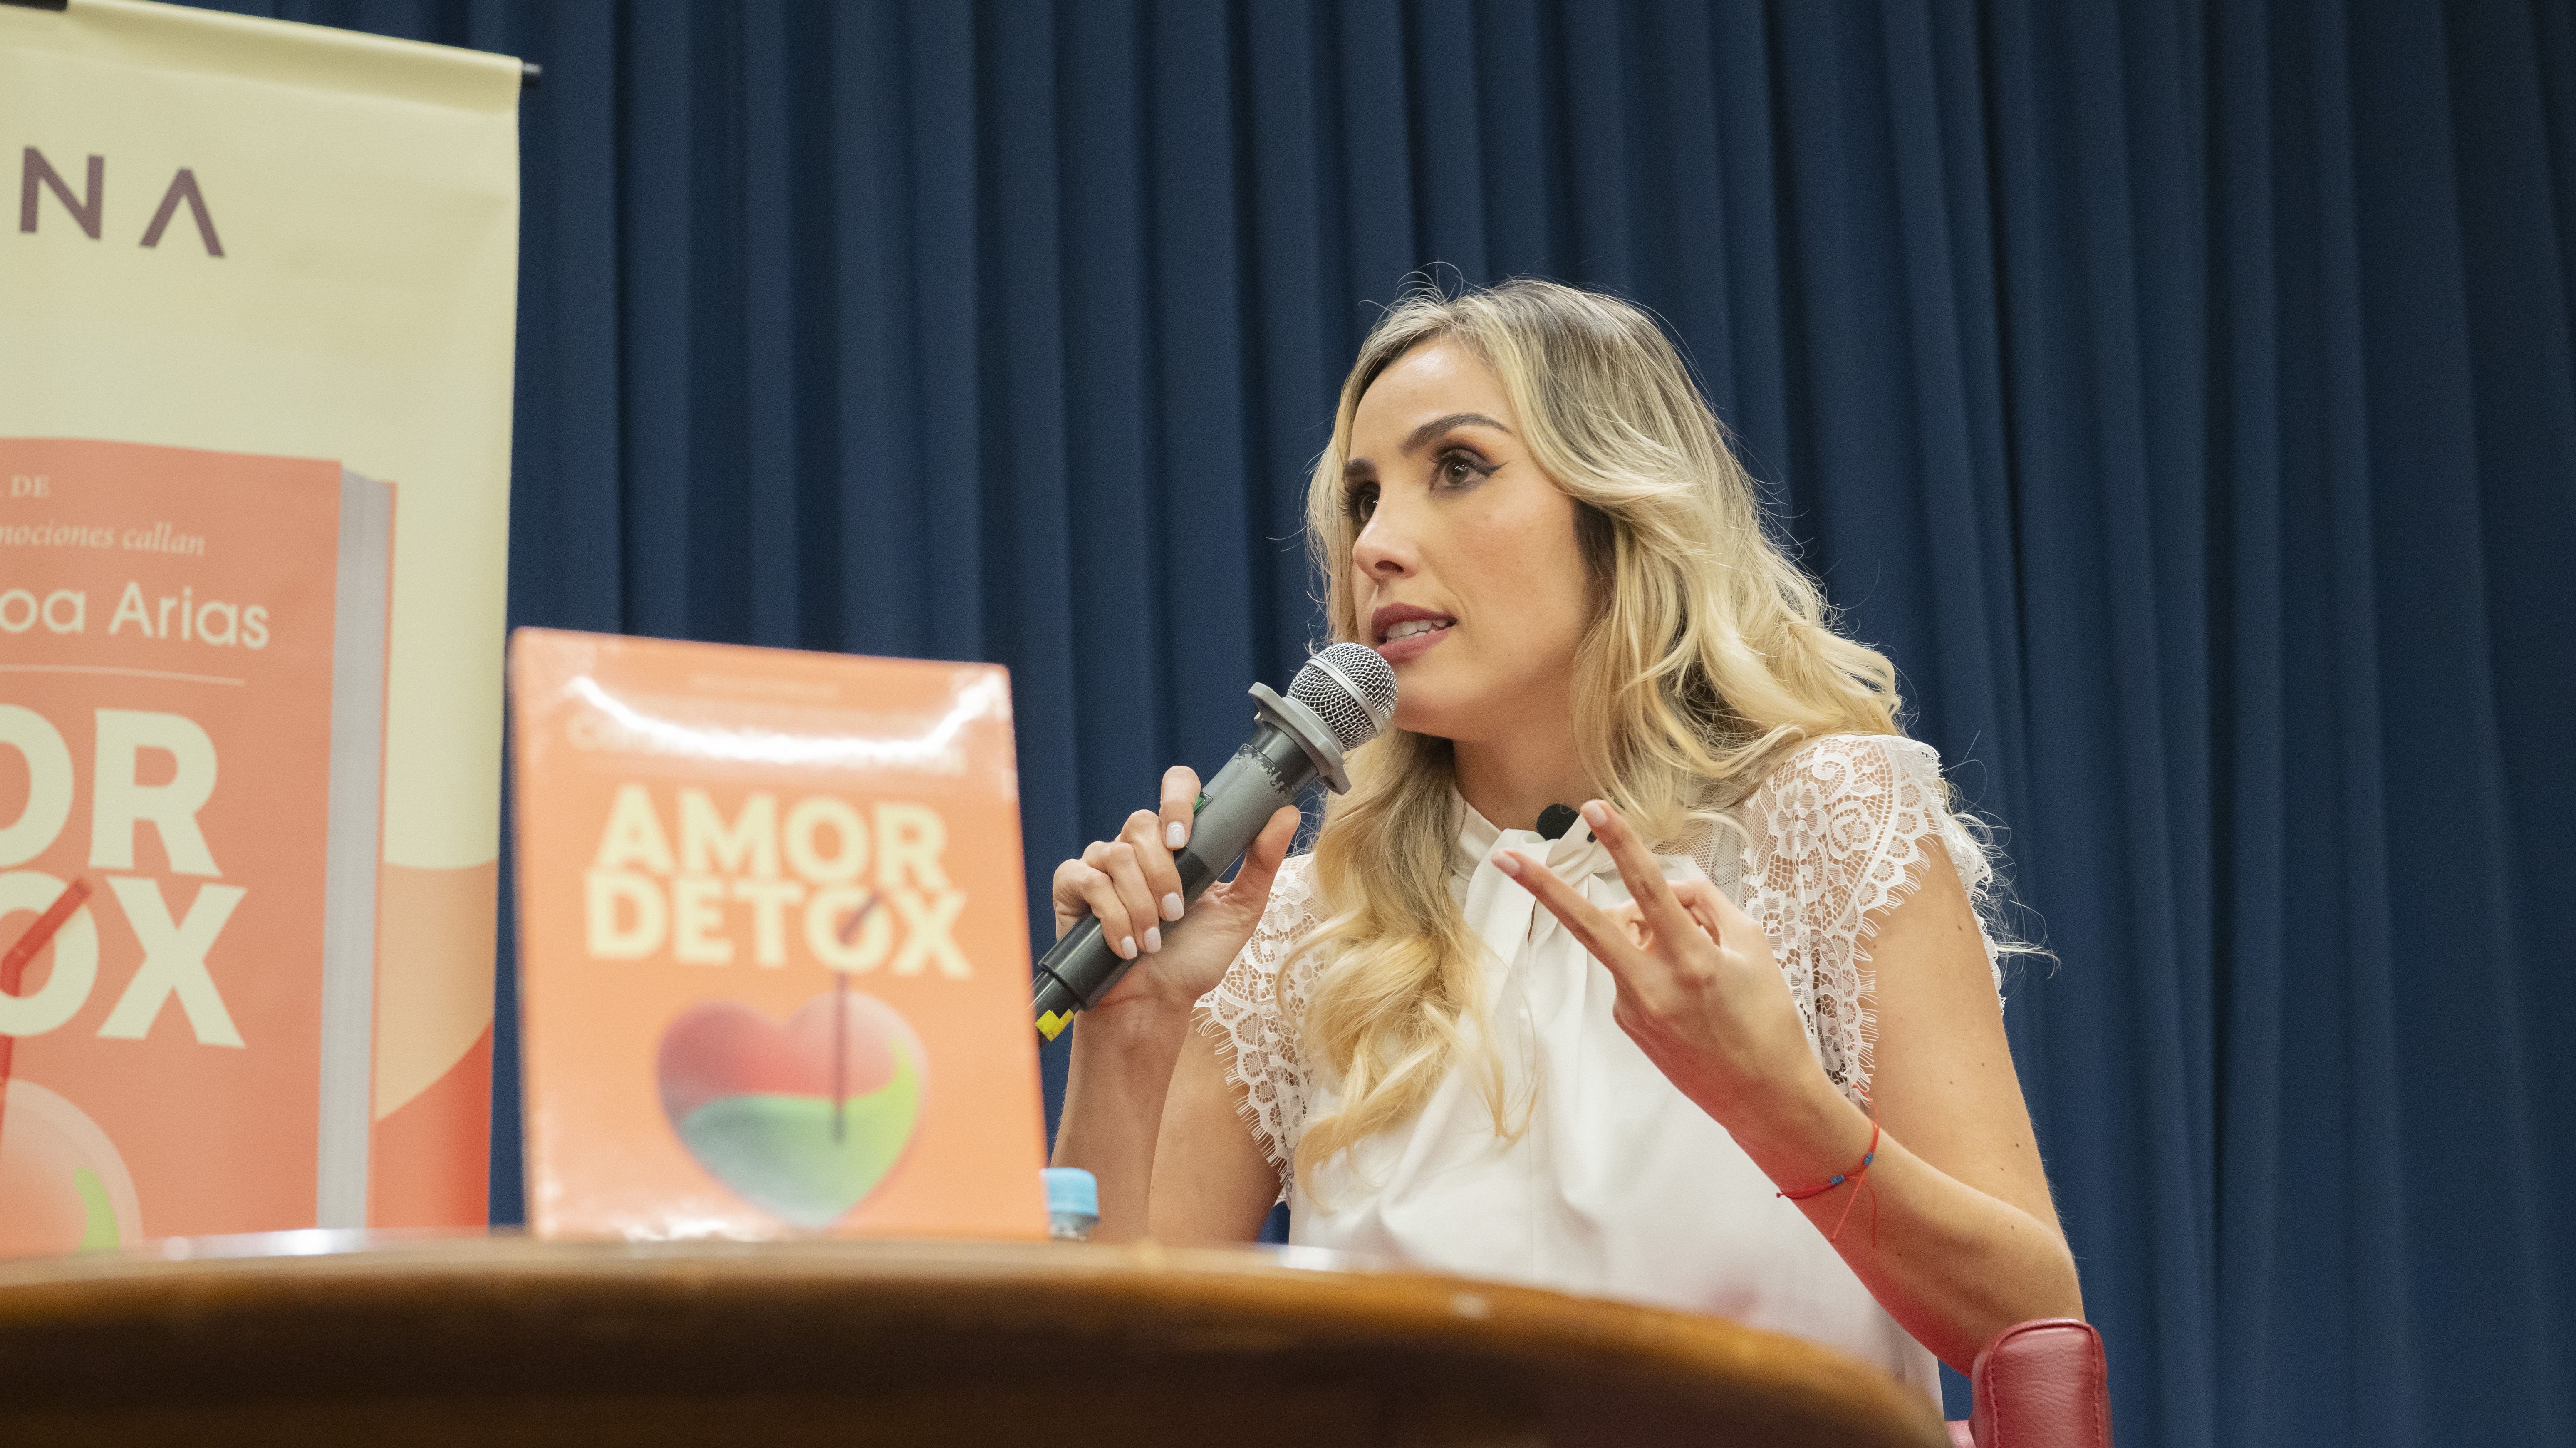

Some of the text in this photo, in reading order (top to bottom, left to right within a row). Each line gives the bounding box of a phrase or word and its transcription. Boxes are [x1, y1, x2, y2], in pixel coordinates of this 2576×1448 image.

[12, 474, 50, 498] DE
[123, 521, 205, 557] callan
[0, 580, 270, 649] oa Arias
[593, 783, 957, 894] AMOR
[587, 868, 976, 980] DETOX
